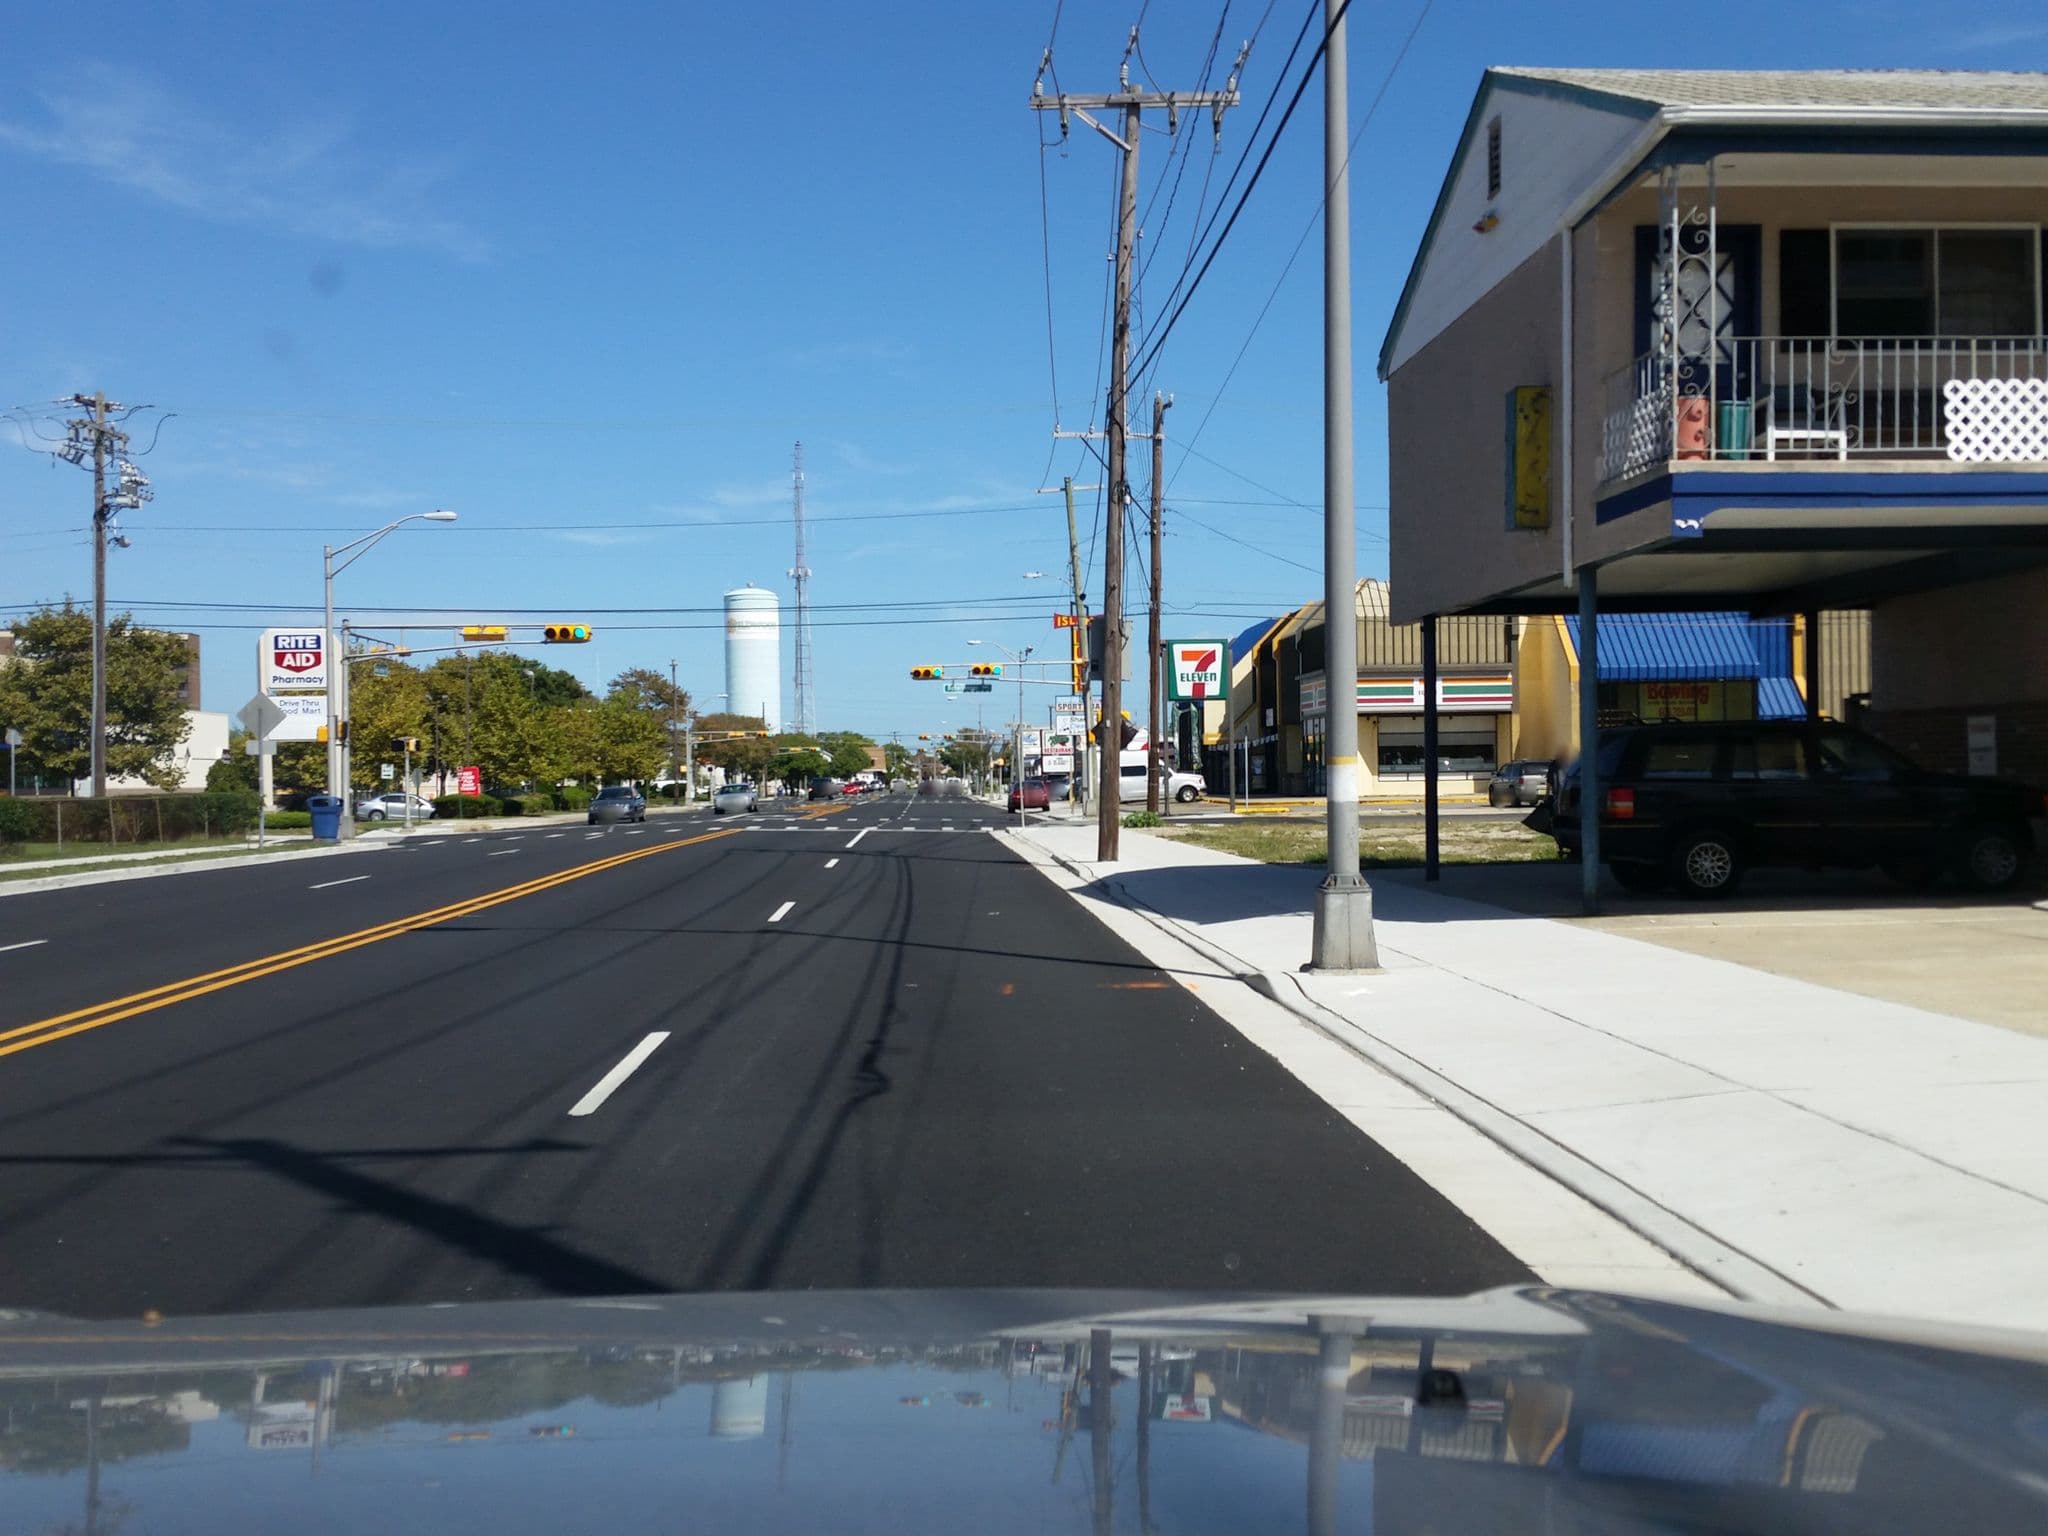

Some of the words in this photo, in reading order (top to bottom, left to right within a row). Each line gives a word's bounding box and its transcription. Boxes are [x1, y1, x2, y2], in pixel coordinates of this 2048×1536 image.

[277, 636, 318, 649] RITE
[282, 653, 316, 667] AID
[1181, 648, 1216, 698] 7
[272, 675, 324, 684] Pharmacy
[279, 699, 300, 707] Drive
[302, 699, 320, 707] Thru
[1057, 703, 1083, 711] SPORT
[302, 707, 321, 715] Mart
